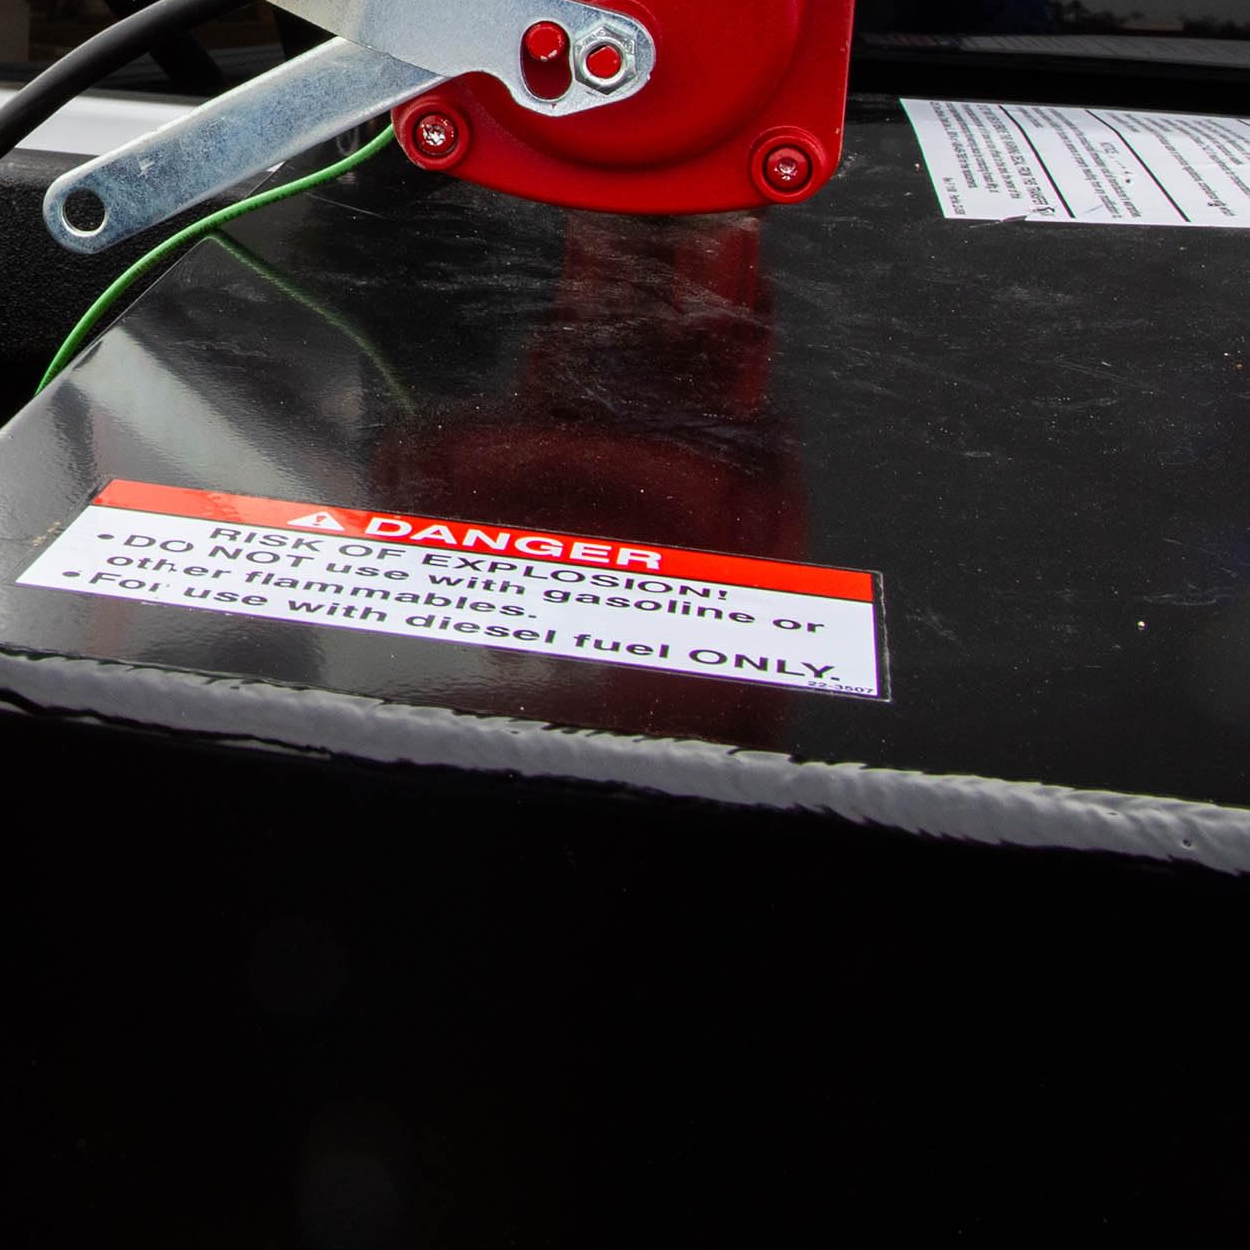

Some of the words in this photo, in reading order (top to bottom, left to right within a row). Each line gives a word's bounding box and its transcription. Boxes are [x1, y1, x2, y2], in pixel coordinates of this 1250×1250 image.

[209, 526, 323, 552] RISK
[338, 543, 406, 561] OF
[421, 553, 730, 601] EXPLOSION!
[363, 516, 662, 571] DANGER
[106, 554, 232, 581] other
[240, 570, 539, 619] flammables.
[123, 534, 194, 554] DO
[209, 546, 314, 568] NOT
[327, 562, 411, 582] use
[428, 573, 527, 596] with
[543, 585, 756, 625] gasoline
[772, 616, 826, 634] or
[89, 571, 171, 593] For
[184, 586, 269, 607] use
[288, 599, 389, 623] with
[405, 612, 555, 645] diesel
[574, 633, 669, 660] fuel
[688, 649, 841, 682] ONLY.
